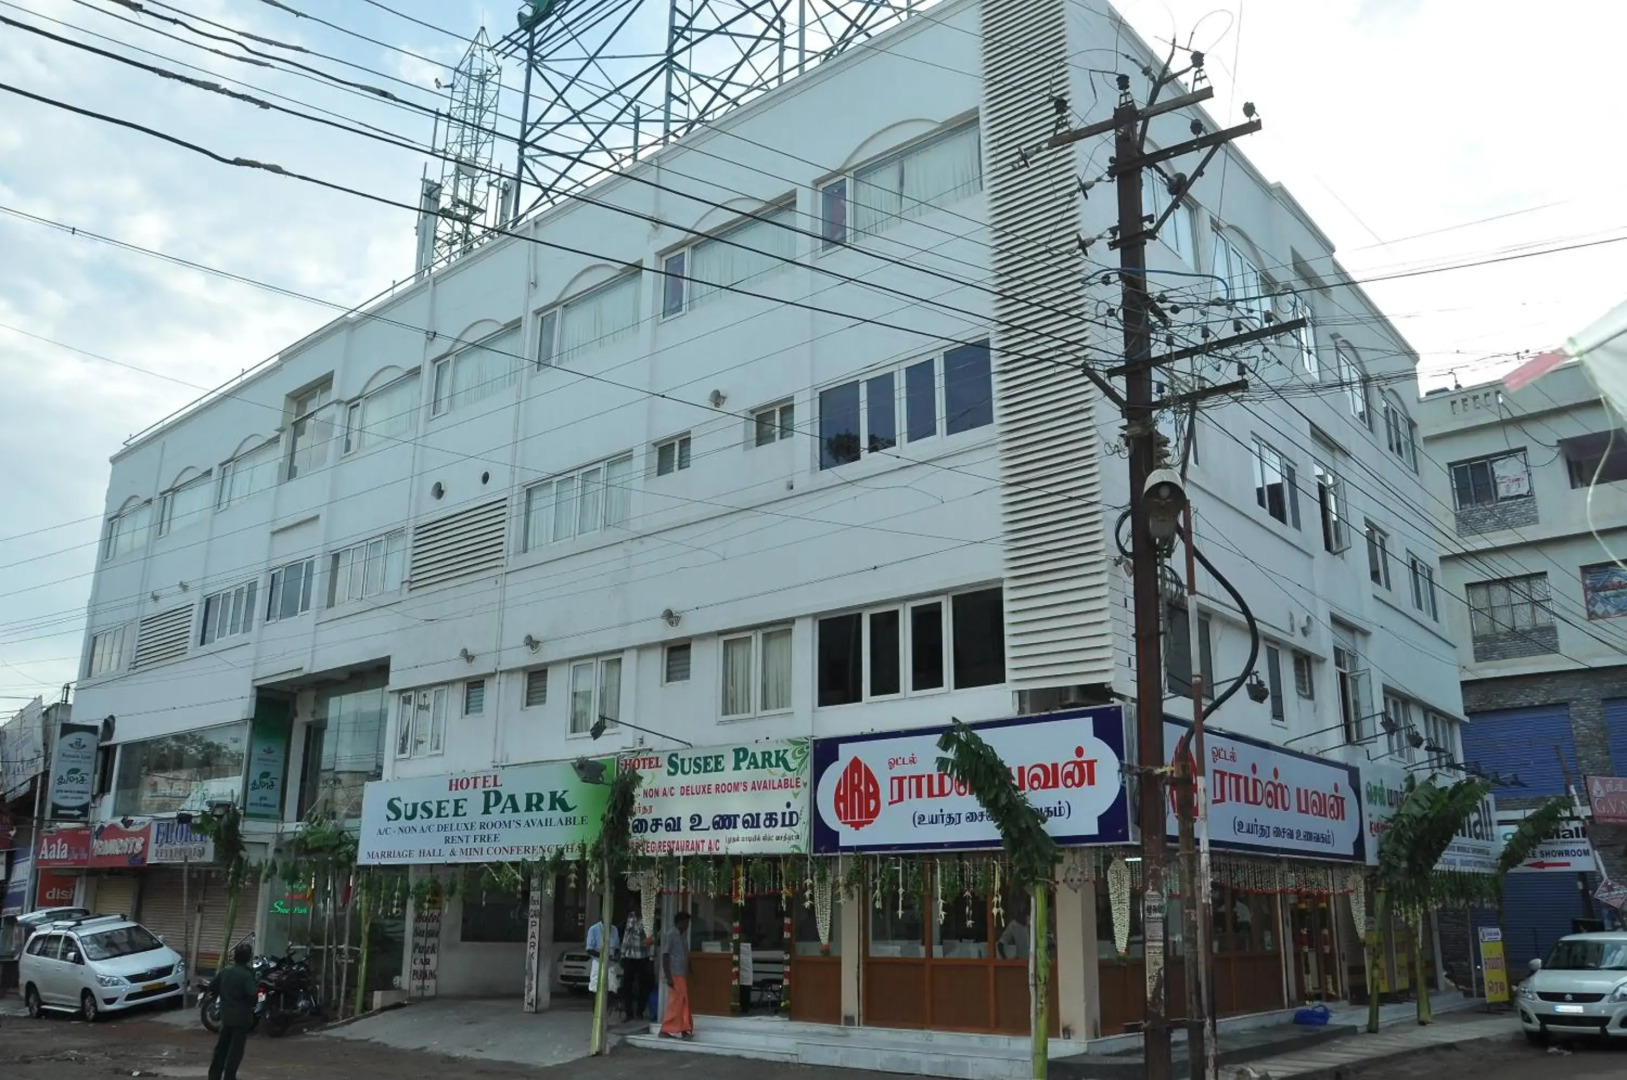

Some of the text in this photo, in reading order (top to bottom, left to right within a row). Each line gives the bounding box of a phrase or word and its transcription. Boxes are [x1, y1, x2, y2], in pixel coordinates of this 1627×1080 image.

[624, 747, 796, 776] HOTEL SUSEE PARK
[887, 752, 918, 770] ஓட்டல்
[1211, 745, 1238, 764] ஓட்டல்
[448, 774, 503, 791] HOTEL
[643, 786, 660, 798] NON
[662, 785, 675, 797] A/C
[680, 784, 712, 796] DELUXE
[750, 777, 802, 792] AVAILABLE
[834, 756, 881, 821] HRB
[1211, 762, 1346, 821] ராம்ஸ் பவன்
[385, 789, 577, 822] SUSEE PARK
[376, 825, 392, 836] A/C
[398, 824, 418, 835] NON
[419, 823, 436, 834] A/C
[437, 821, 477, 832] DELUXE
[523, 815, 588, 829] AVAILABLE
[689, 801, 799, 832] உணவகம்
[39, 837, 68, 860] Aala
[444, 833, 501, 845] RENT FREE
[658, 839, 705, 853] RESTAURANT
[366, 849, 414, 859] MARRIAGE
[418, 848, 445, 858] HALL
[449, 848, 457, 857] &
[459, 846, 484, 857] MINI
[1539, 848, 1591, 858] SHOWROOM
